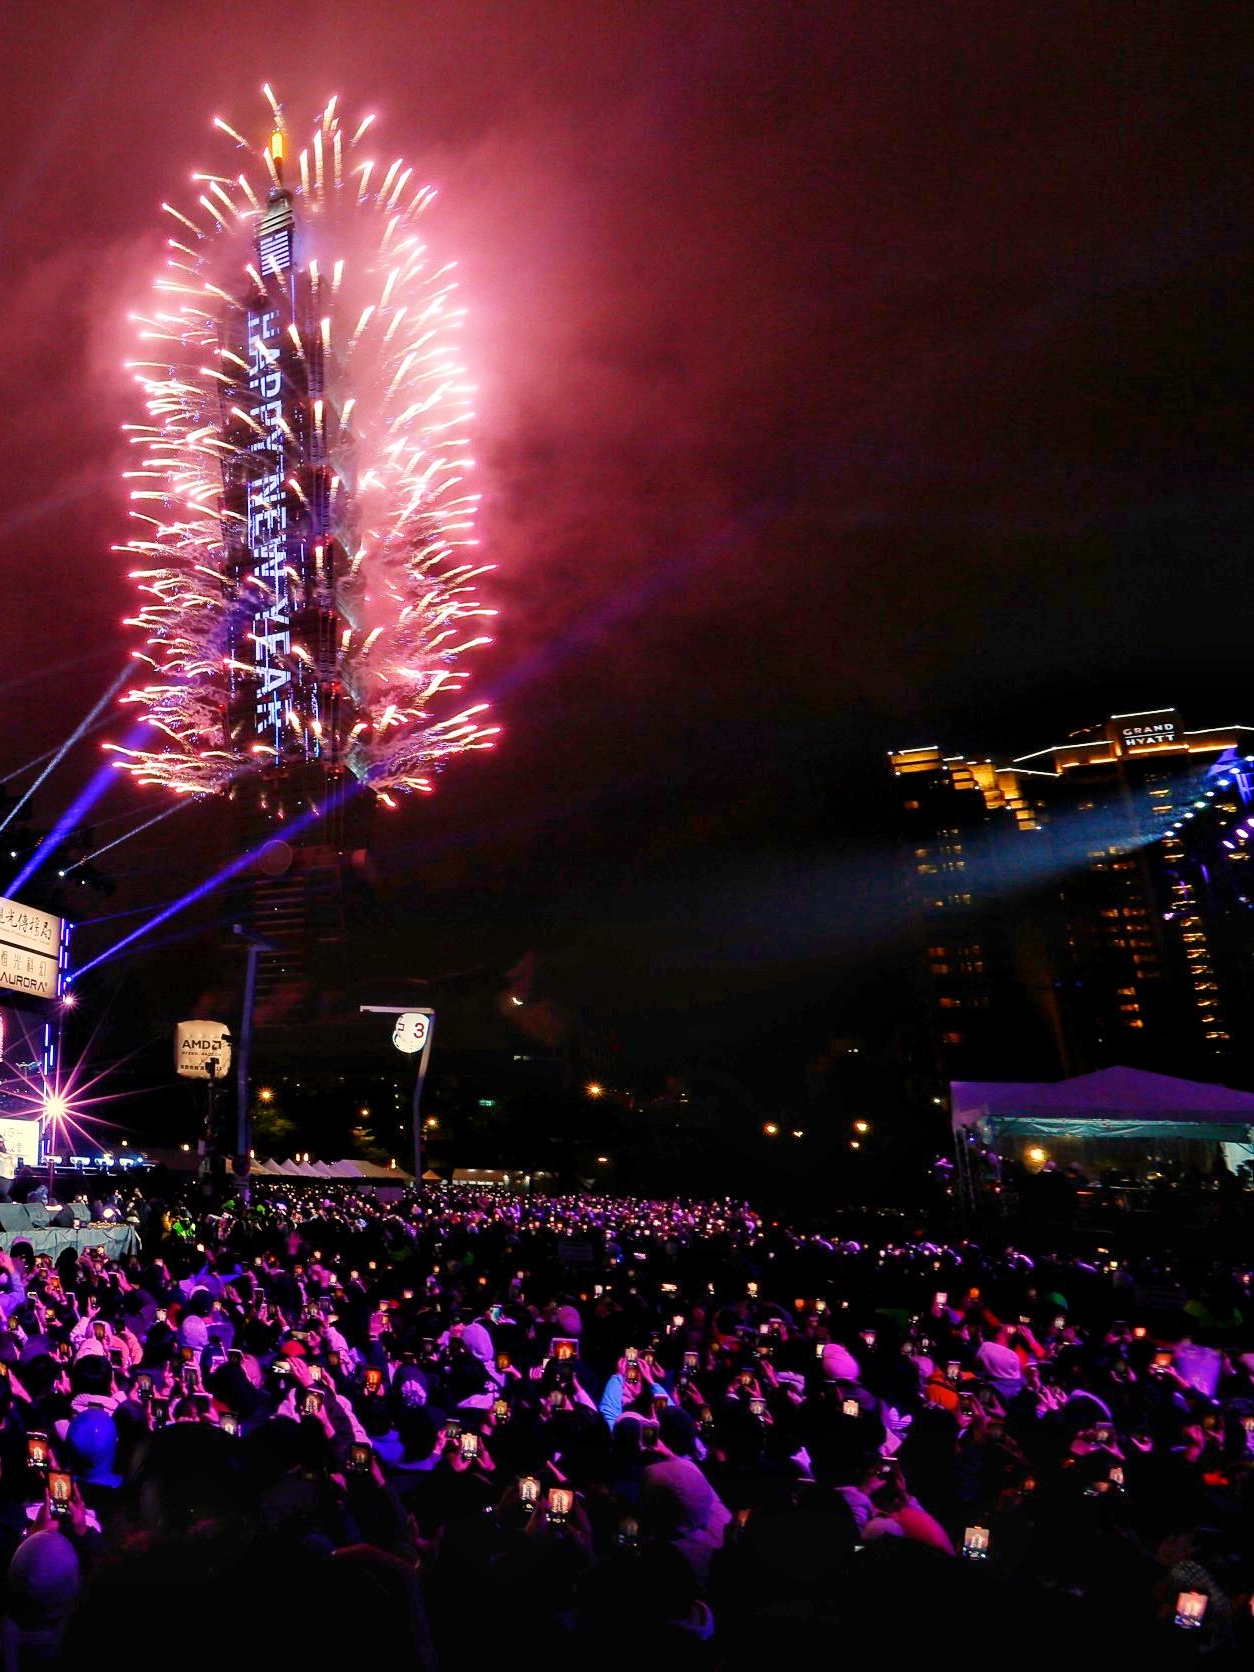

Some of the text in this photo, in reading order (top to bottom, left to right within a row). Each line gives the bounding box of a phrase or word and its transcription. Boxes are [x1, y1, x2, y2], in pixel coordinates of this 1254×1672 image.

[1122, 723, 1174, 736] GRAND
[1126, 734, 1175, 746] HYATT
[0, 972, 45, 993] AURORA
[413, 1022, 425, 1039] 3
[182, 1039, 211, 1050] AMD
